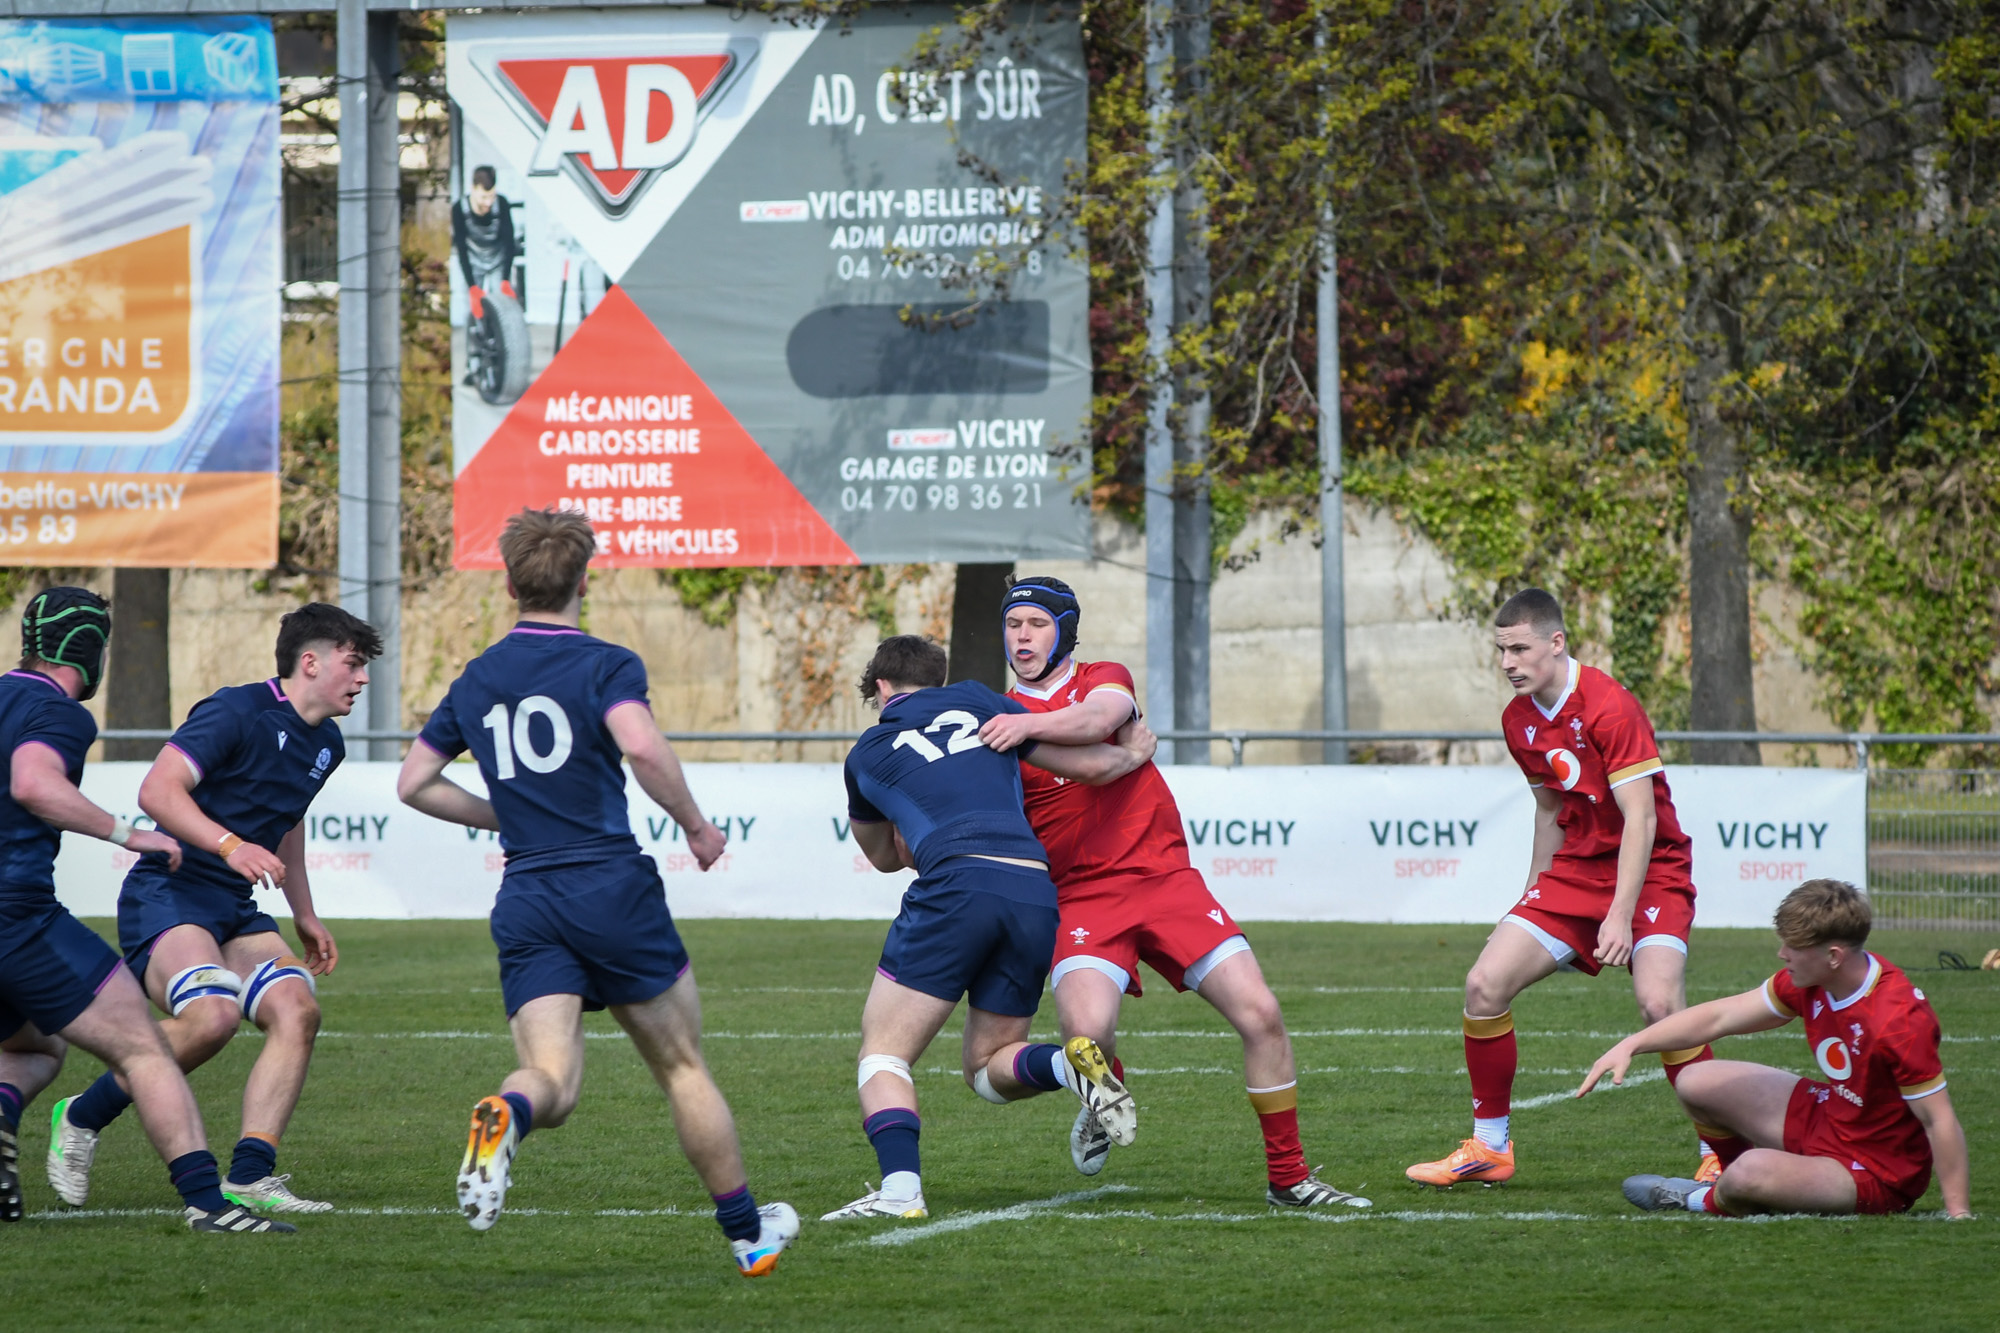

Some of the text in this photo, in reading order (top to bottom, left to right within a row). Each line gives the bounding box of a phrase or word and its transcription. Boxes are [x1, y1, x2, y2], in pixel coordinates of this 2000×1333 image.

[808, 73, 866, 136] AD,
[975, 56, 1043, 121] SÛR
[528, 62, 698, 177] AD
[829, 225, 886, 250] ADM
[837, 254, 871, 281] 04
[544, 390, 693, 423] MÉCANIQUE
[538, 428, 700, 456] CARROSSERIE
[958, 418, 1046, 449] VICHY
[566, 462, 673, 489] PEINTURE
[839, 453, 1049, 482] GARAGE DE LYON
[841, 482, 1042, 512] 04 70 98 36 21
[37, 514, 77, 545] 83
[617, 523, 740, 555] VÉHICULES
[482, 695, 573, 780] 10
[892, 709, 986, 763] 12
[311, 815, 389, 841] ICHY
[648, 816, 756, 842] VIHY
[1189, 820, 1296, 846] VICHY
[1369, 820, 1479, 847] VICHY
[1717, 821, 1828, 849] VICHY
[665, 853, 733, 873] SPT
[1212, 857, 1278, 877] SPORT
[1394, 858, 1461, 878] SPORT
[1739, 861, 1808, 881] SPORT
